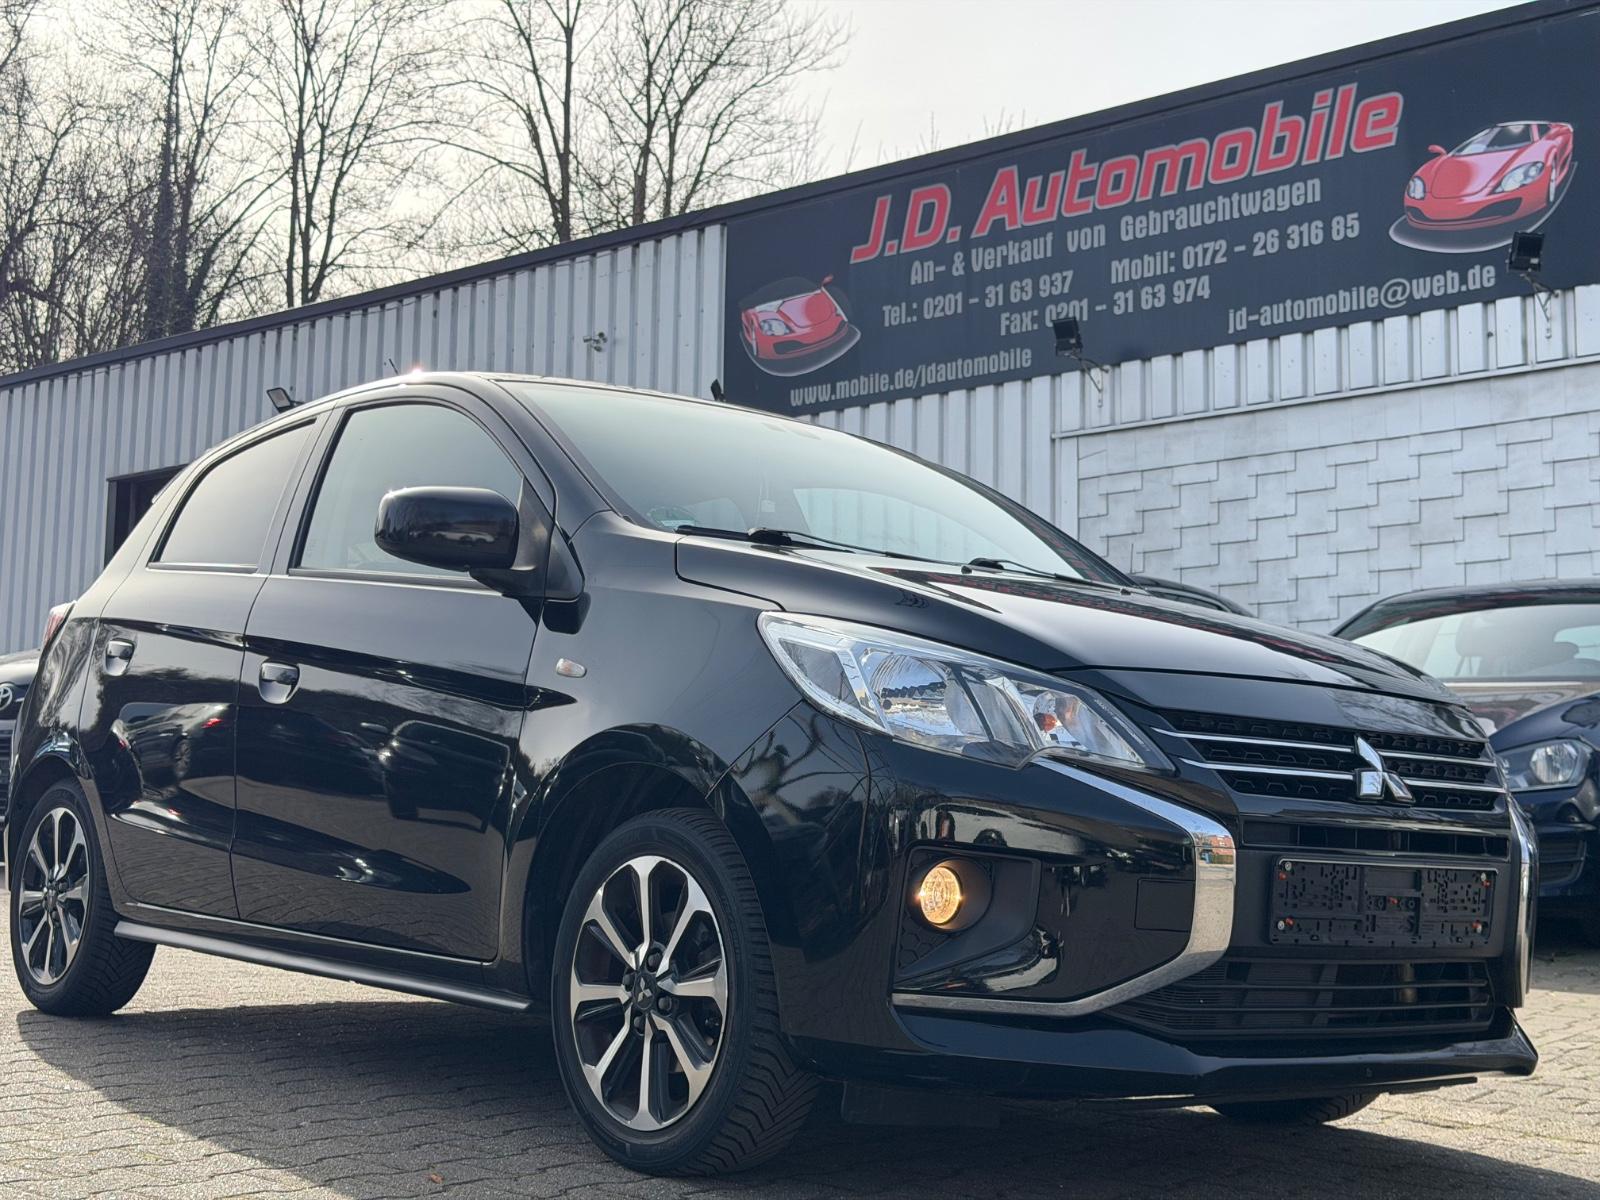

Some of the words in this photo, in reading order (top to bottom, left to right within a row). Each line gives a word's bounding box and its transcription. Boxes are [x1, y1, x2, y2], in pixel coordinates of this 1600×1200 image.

[850, 183, 961, 264] J.D.
[971, 83, 1404, 239] Automobile
[910, 260, 946, 285] An-
[952, 252, 965, 276] &
[971, 233, 1053, 272] Verkauf
[1067, 224, 1106, 252] von
[1120, 178, 1321, 242] Gebrauchtwagen
[1111, 250, 1175, 284] Mobil:
[1182, 240, 1227, 270] 0172
[1253, 229, 1279, 257] 26
[1286, 220, 1323, 250] 316
[1332, 213, 1360, 241] 85
[883, 302, 917, 327] Tel.:
[923, 292, 963, 319] 0201
[985, 284, 1003, 307] 31
[1010, 278, 1032, 303] 63
[1039, 270, 1074, 297] 937
[1000, 310, 1038, 336] Fax:
[1113, 290, 1134, 315] 31
[1140, 283, 1165, 310] 63
[1173, 275, 1210, 304] 974
[1228, 265, 1496, 334] jd-automobile@web.de
[790, 348, 1032, 407] www.mobile.de/jdautomobile
